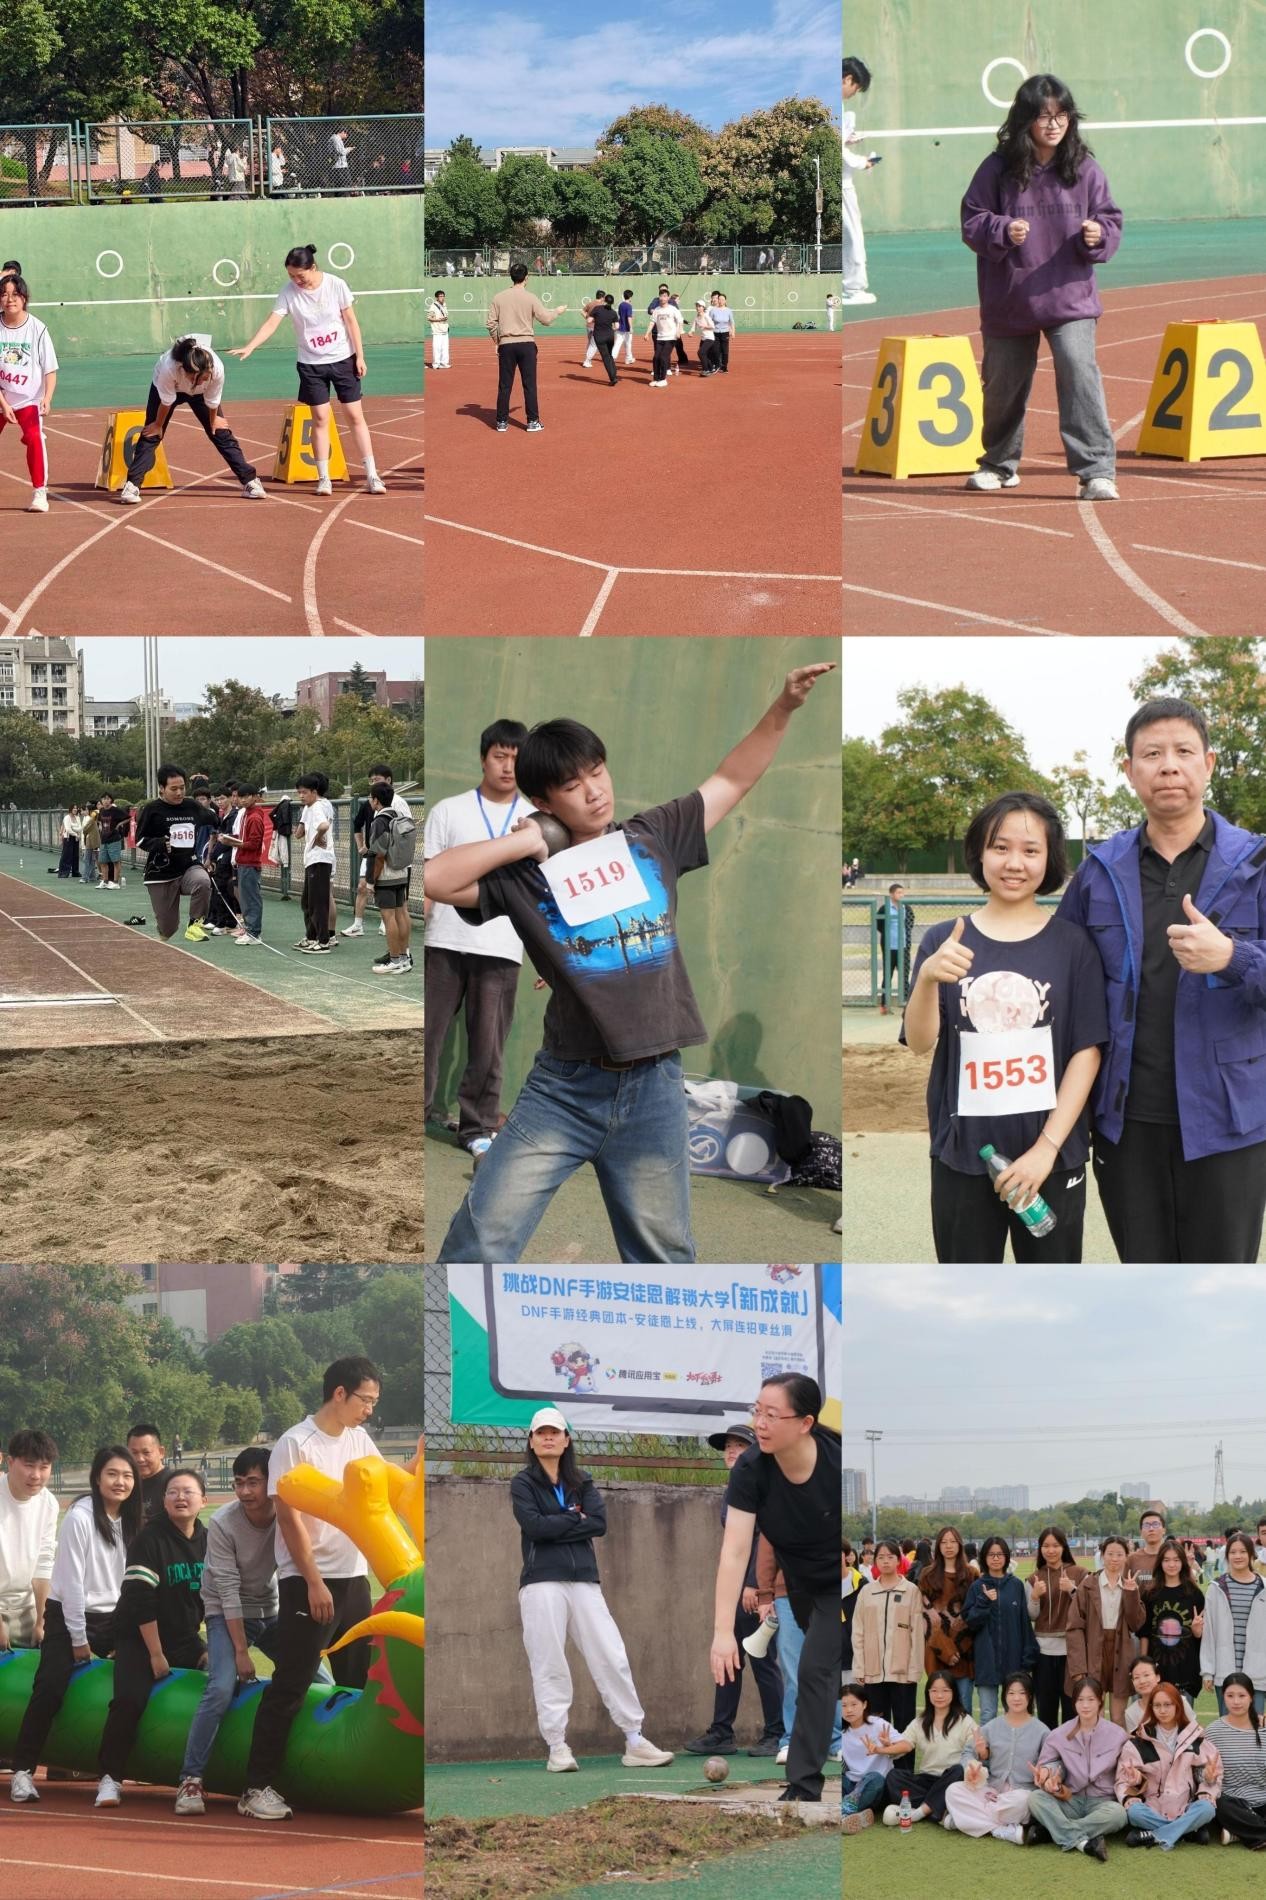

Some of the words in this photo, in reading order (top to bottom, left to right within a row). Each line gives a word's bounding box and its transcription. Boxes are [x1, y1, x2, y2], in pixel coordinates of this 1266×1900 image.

[310, 331, 338, 348] 1847
[871, 362, 898, 447] 3
[918, 362, 974, 447] 3
[1152, 347, 1189, 430] 2
[1207, 348, 1262, 431] 2
[279, 418, 292, 466] 5
[172, 830, 194, 840] 1516
[564, 861, 625, 899] 1519
[965, 1055, 1047, 1090] 1553
[618, 1369, 661, 1381] 腾讯应用宝
